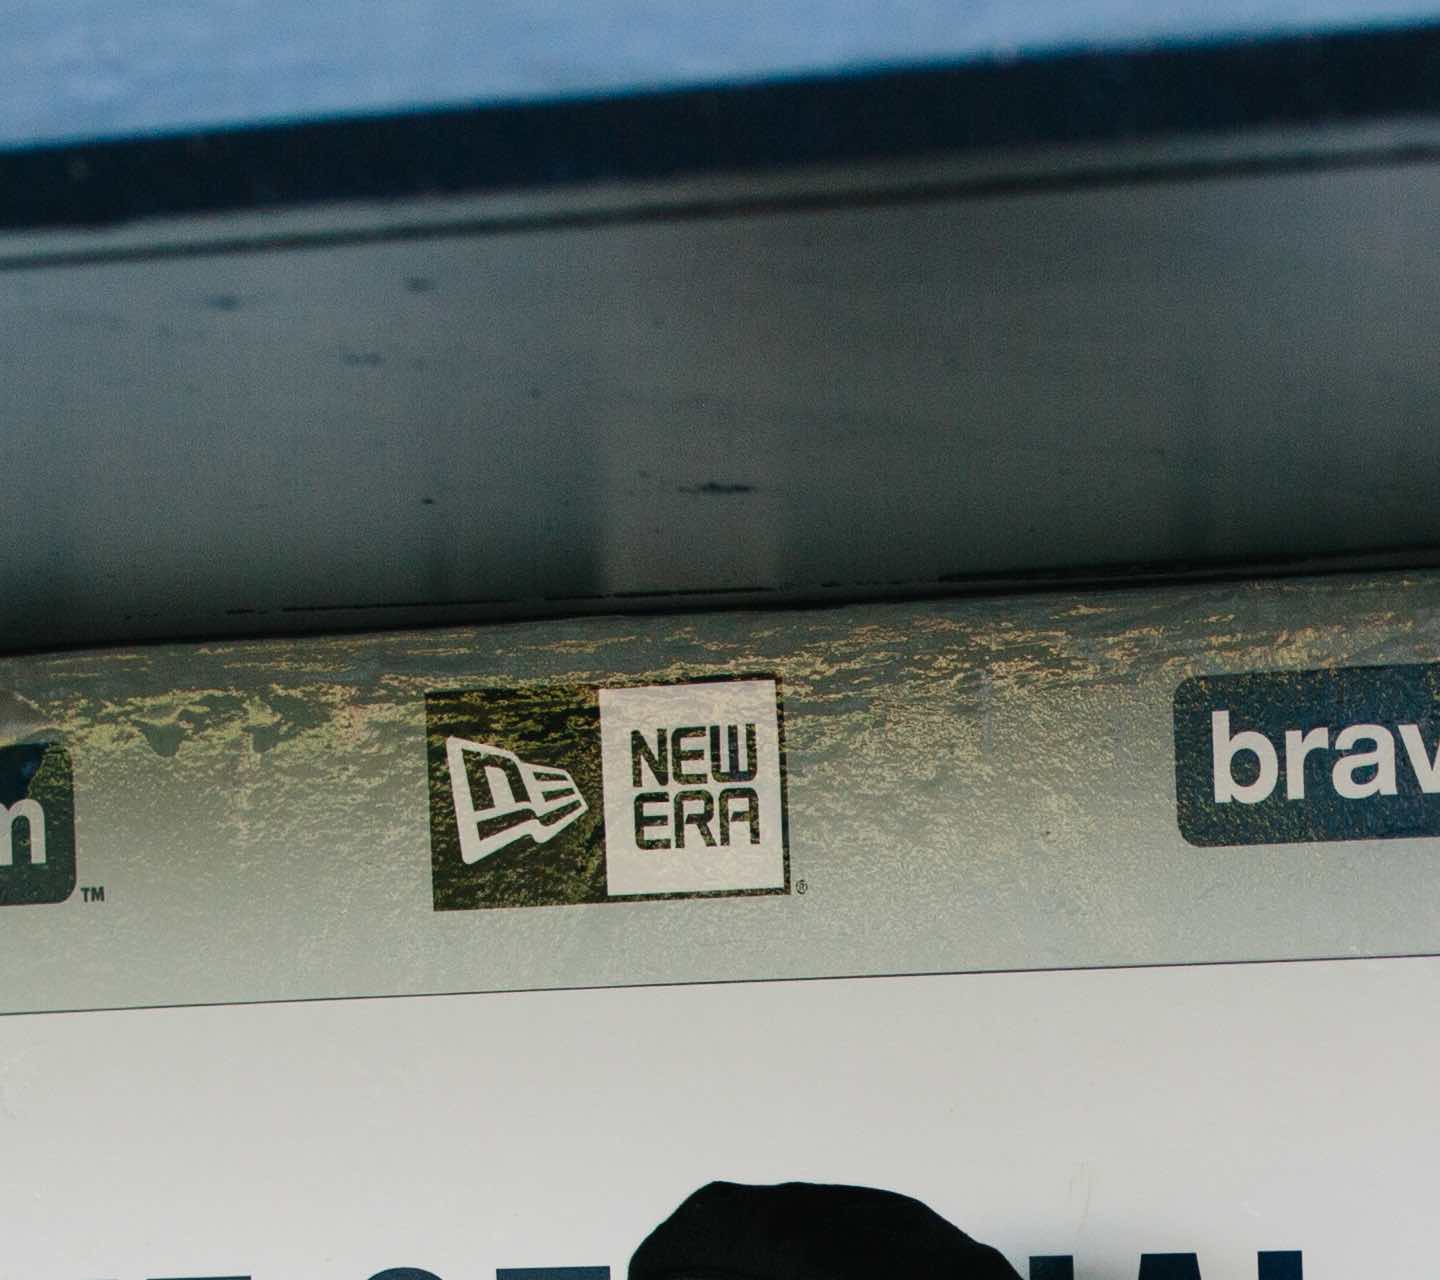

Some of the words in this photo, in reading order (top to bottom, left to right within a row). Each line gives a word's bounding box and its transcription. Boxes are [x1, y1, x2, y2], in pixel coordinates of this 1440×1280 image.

[630, 722, 758, 784] NEW
[633, 785, 761, 851] ERA
[80, 885, 105, 903] TM
